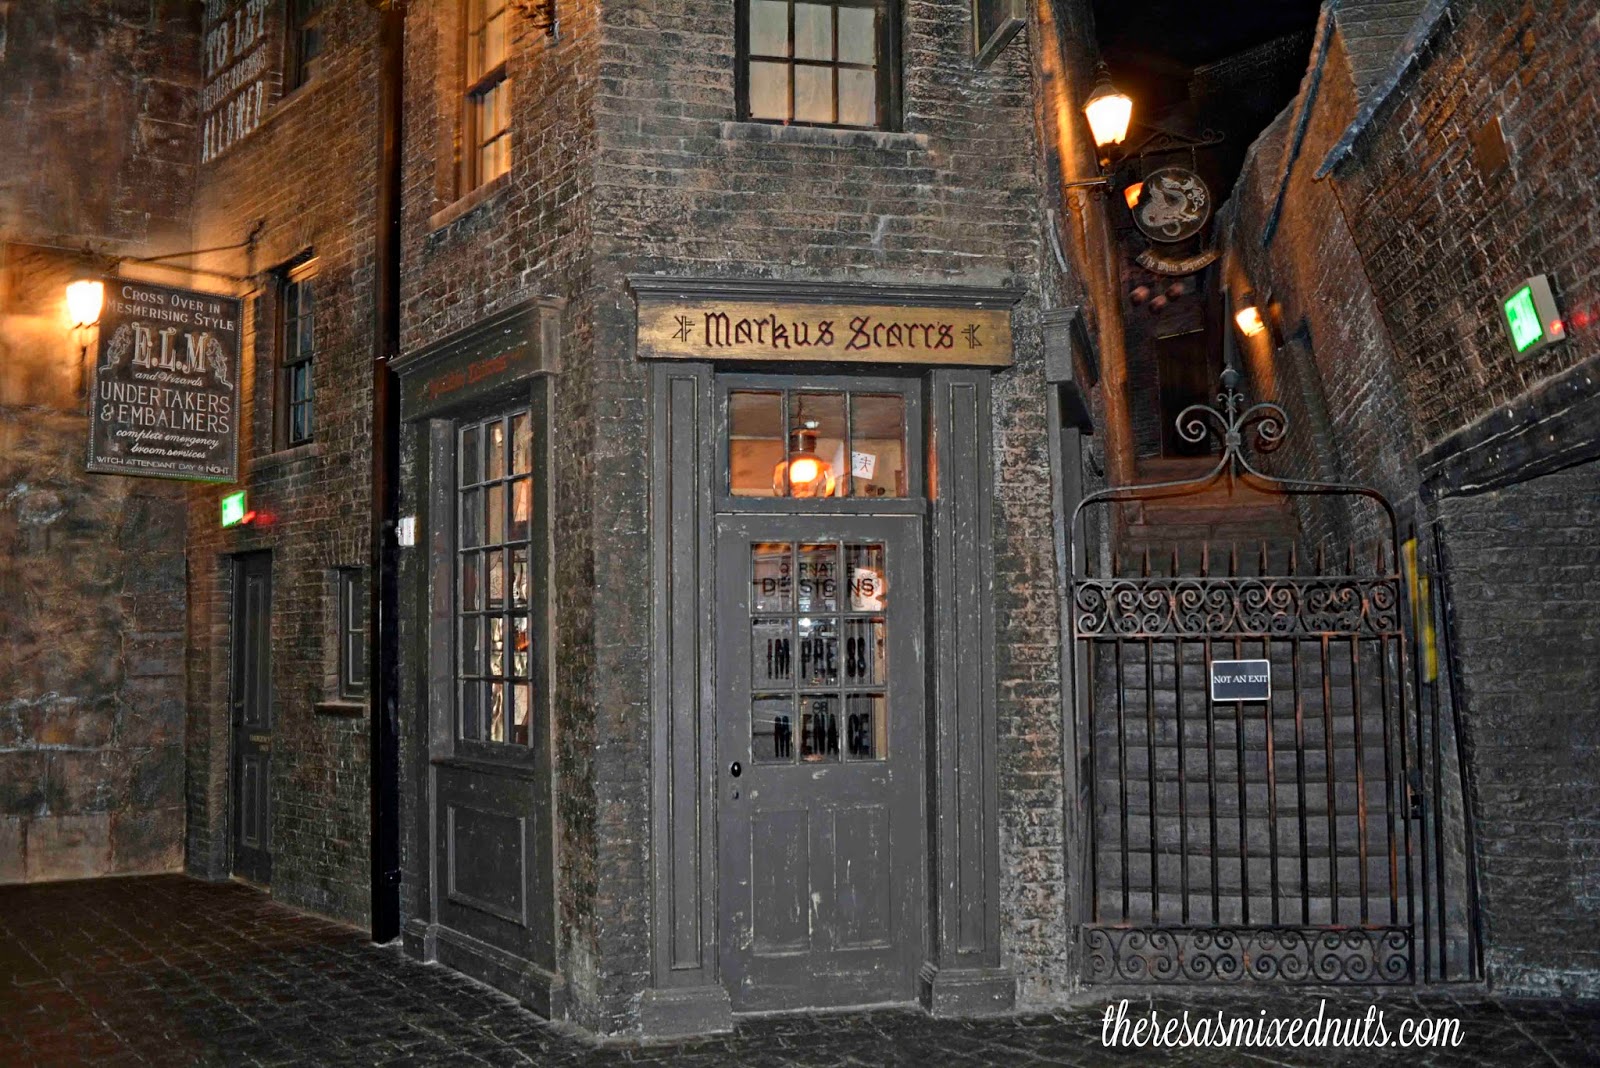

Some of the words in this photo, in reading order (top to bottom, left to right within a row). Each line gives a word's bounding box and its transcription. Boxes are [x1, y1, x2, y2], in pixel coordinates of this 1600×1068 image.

[704, 312, 834, 349] Markus
[845, 315, 954, 351] Scarr's
[135, 371, 157, 381] and
[158, 372, 203, 387] Wizards
[101, 381, 230, 414] UNDERTAKERS
[101, 403, 114, 422] &
[118, 405, 230, 434] EMBALMERS
[116, 429, 163, 443] complete
[165, 433, 219, 449] emergency
[131, 443, 165, 456] broom
[166, 447, 207, 459] services
[96, 456, 124, 465] WITCH
[126, 458, 176, 469] ATTENDANT
[179, 463, 195, 471] DAY
[762, 578, 874, 597] DESIGNS
[1214, 675, 1232, 684] NOT
[1233, 675, 1247, 683] AN
[1248, 674, 1268, 683] EXIT
